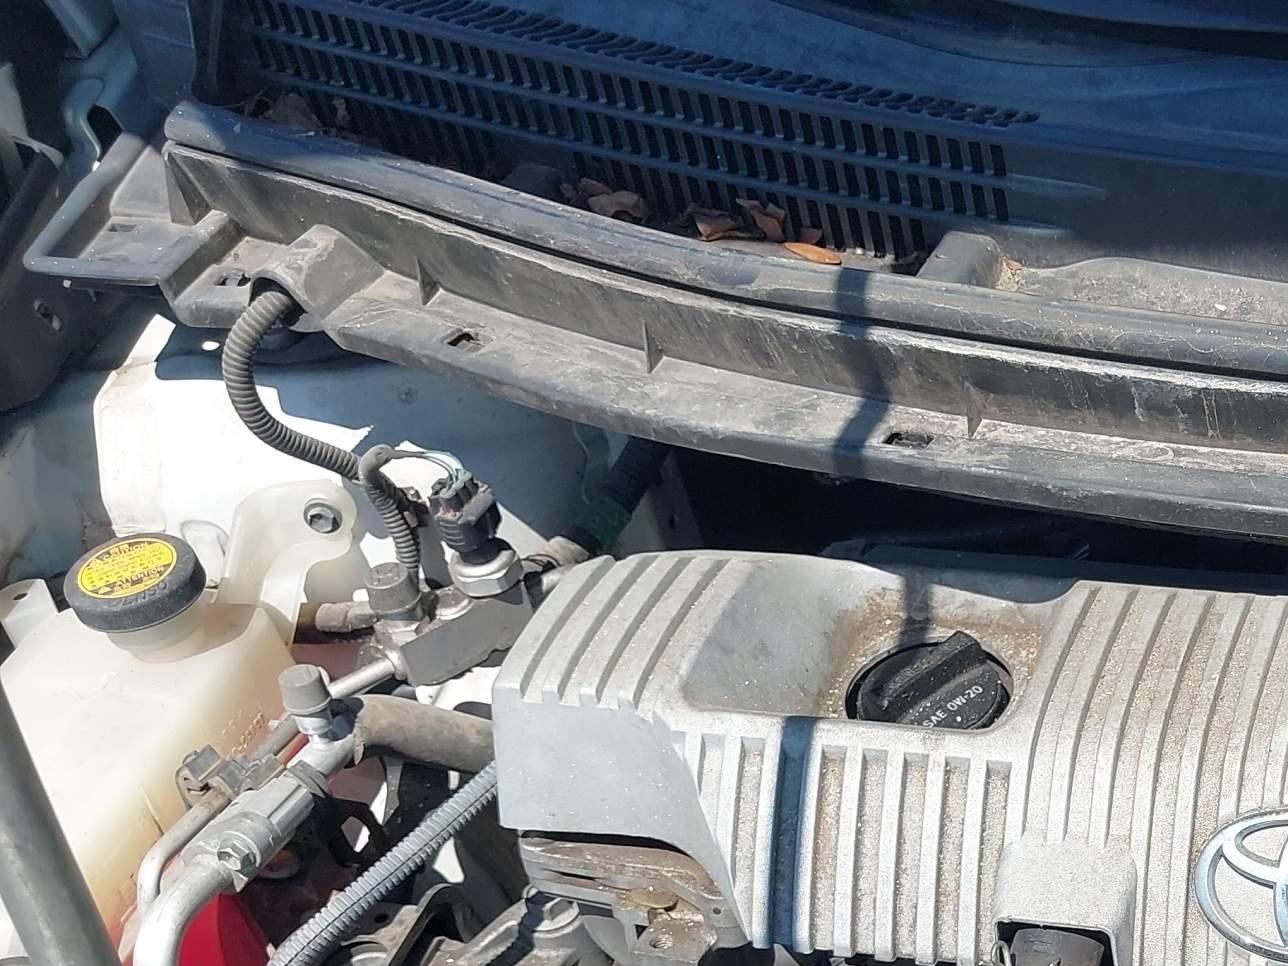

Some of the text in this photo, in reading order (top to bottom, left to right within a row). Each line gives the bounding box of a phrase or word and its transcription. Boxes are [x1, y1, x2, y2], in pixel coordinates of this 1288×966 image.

[116, 566, 164, 585] ATTENTION
[923, 685, 983, 727] SAE 0W-20
